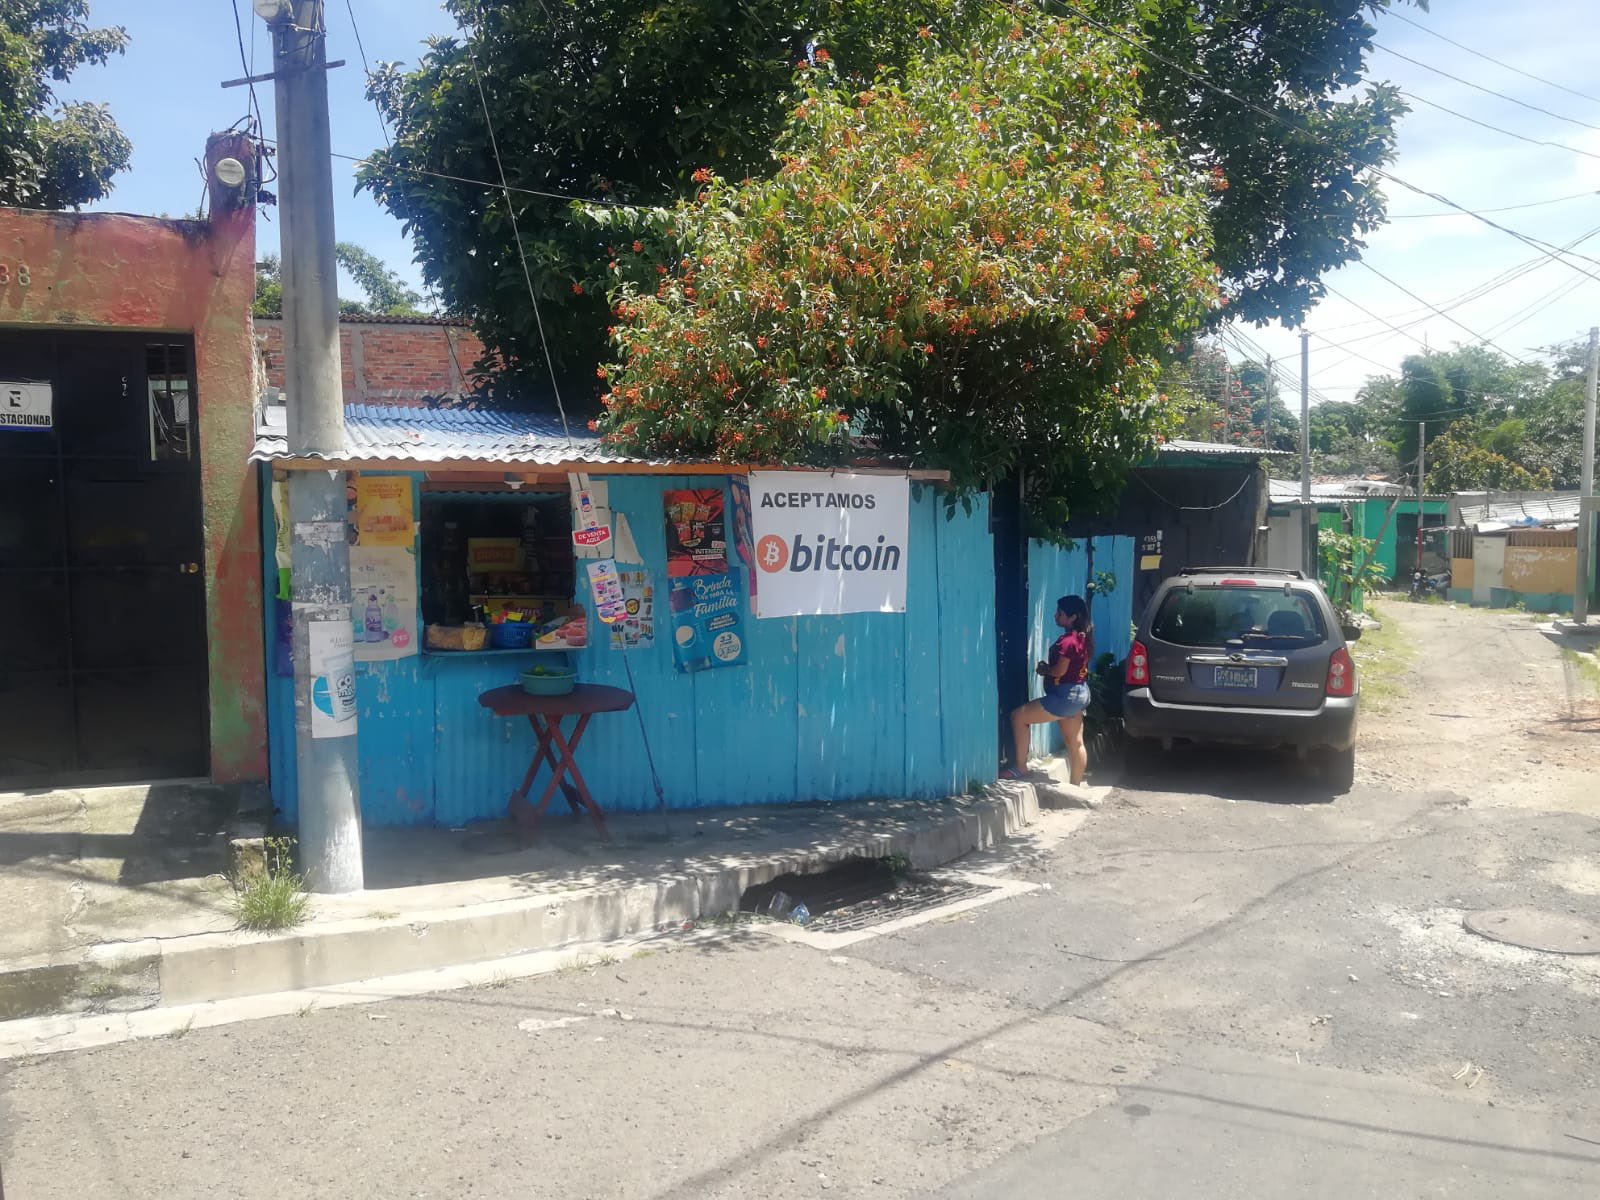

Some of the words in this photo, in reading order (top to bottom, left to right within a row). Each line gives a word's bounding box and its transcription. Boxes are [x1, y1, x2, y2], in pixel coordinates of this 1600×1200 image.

[760, 492, 876, 510] ACEPTAMOS
[789, 534, 901, 572] bitcoin
[693, 575, 732, 598] Brinda
[693, 596, 738, 618] Familia
